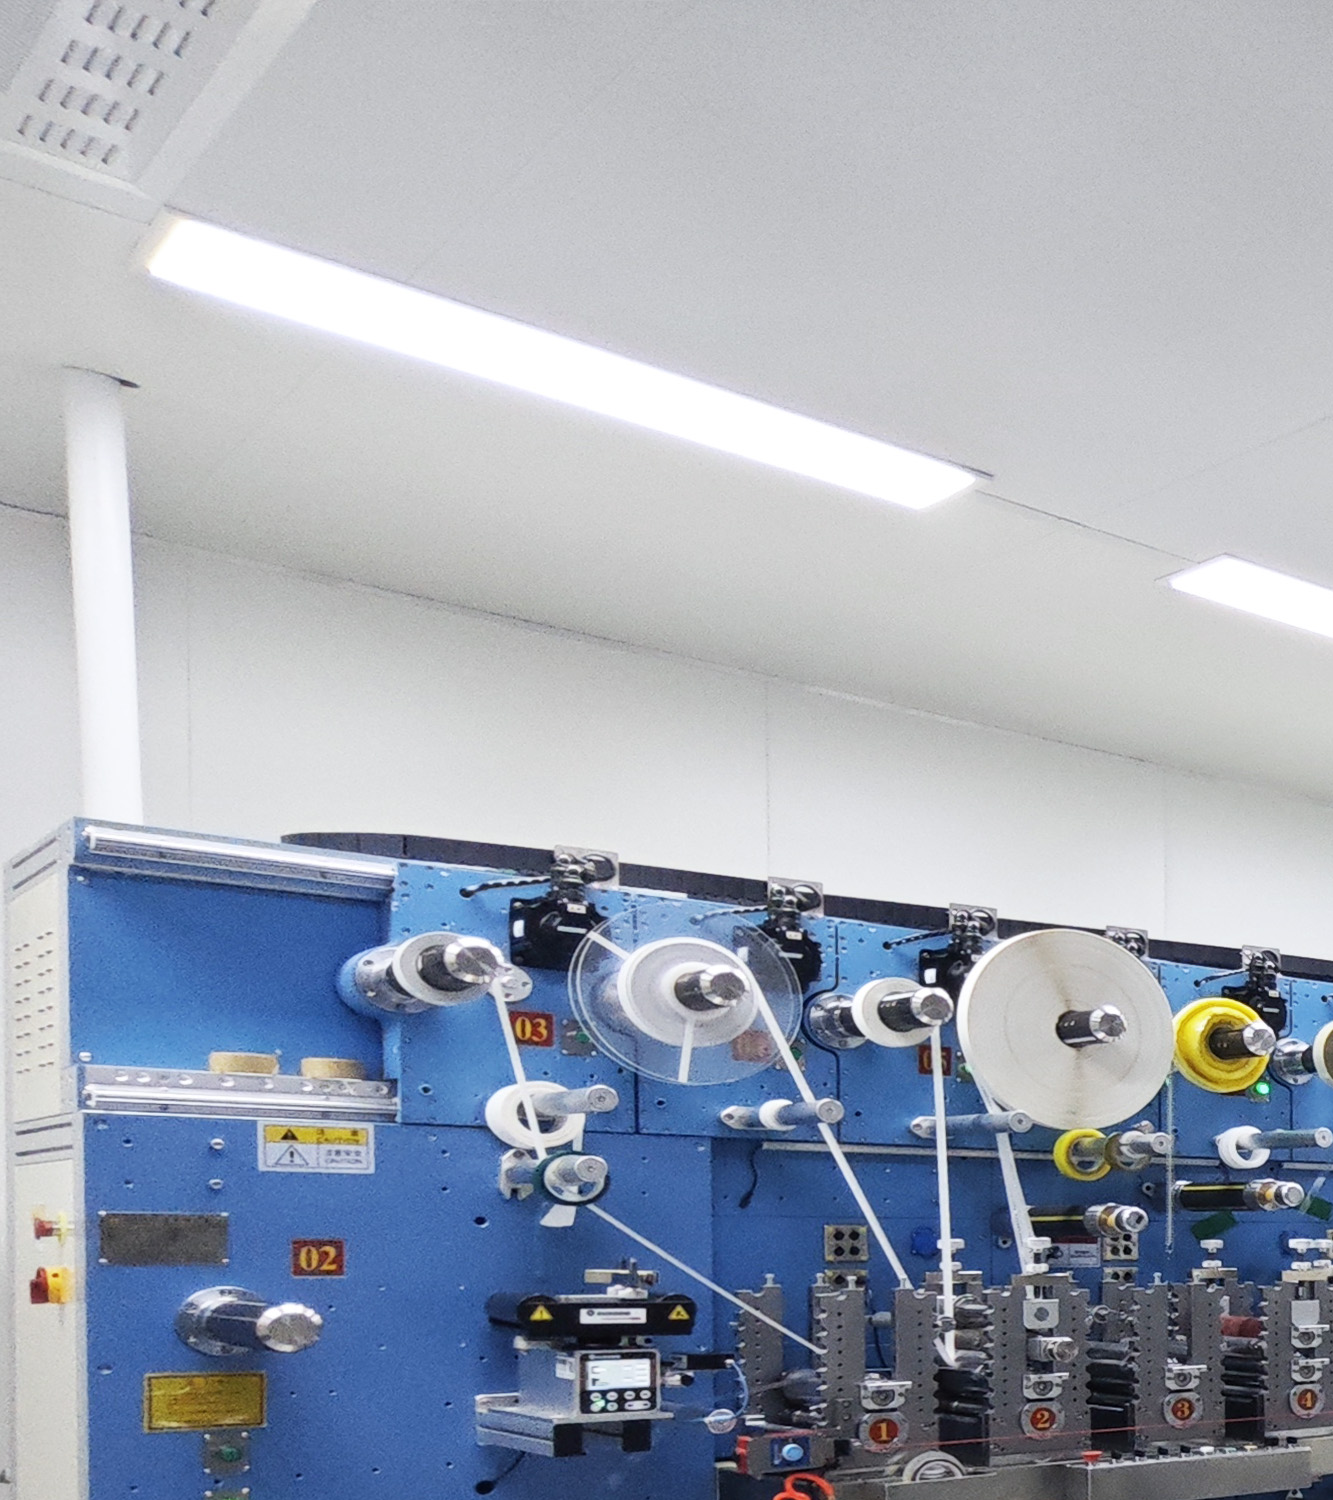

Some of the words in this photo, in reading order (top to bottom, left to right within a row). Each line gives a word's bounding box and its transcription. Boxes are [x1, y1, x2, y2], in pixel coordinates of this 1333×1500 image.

[515, 1016, 548, 1042] 03
[299, 1245, 338, 1271] 02
[1176, 1400, 1190, 1418] 3
[1301, 1391, 1312, 1408] 4
[1036, 1410, 1050, 1429] 2
[877, 1421, 892, 1441] 1
